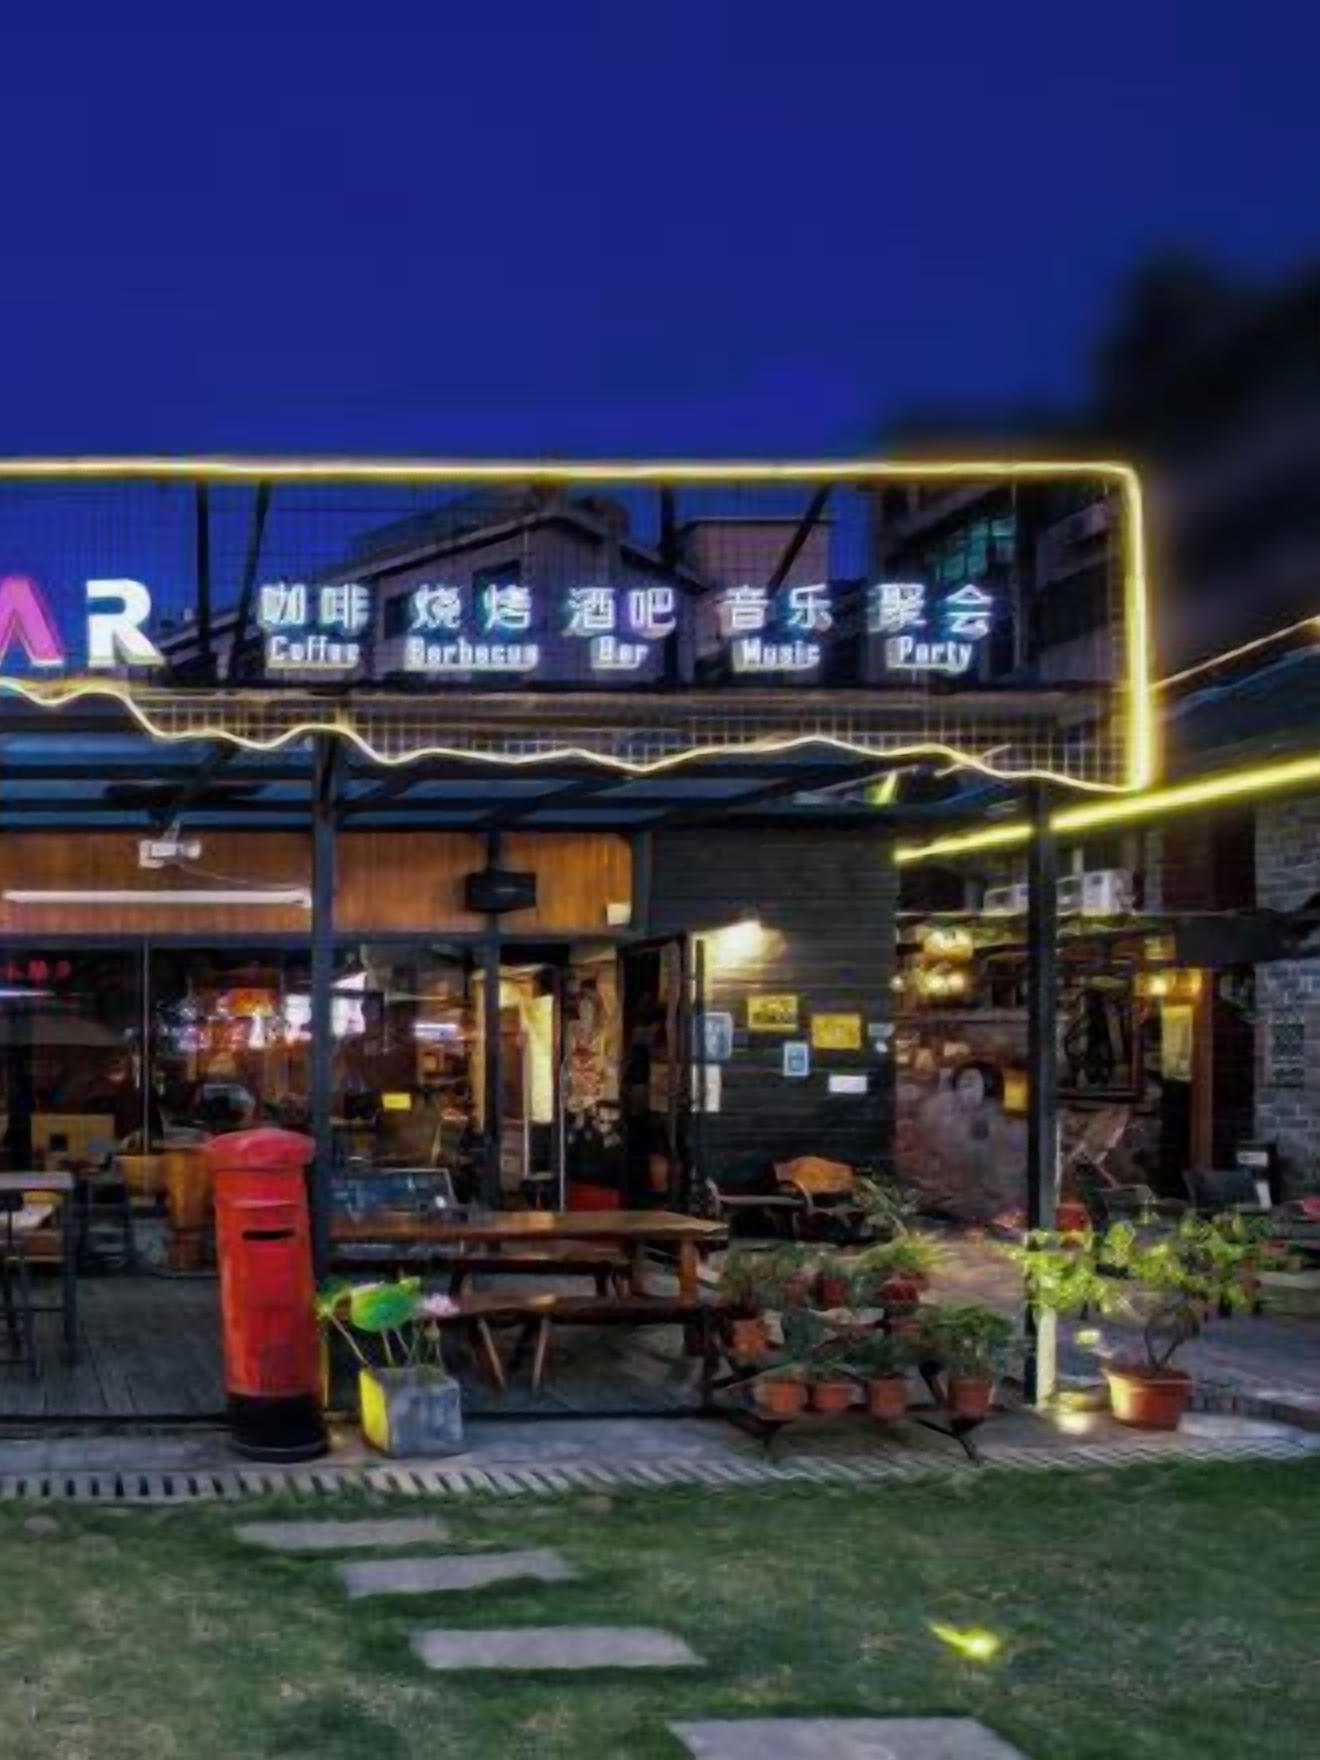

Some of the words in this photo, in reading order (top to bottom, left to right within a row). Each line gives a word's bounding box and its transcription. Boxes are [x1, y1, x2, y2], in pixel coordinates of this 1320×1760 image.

[260, 584, 368, 634] 咖啡
[411, 584, 531, 631] 烧烤
[564, 587, 676, 637] 酒吧
[726, 582, 832, 633] 音乐
[870, 583, 992, 638] 聚会
[268, 635, 360, 668] Coffee
[734, 637, 820, 671] Music
[886, 635, 972, 673] Party
